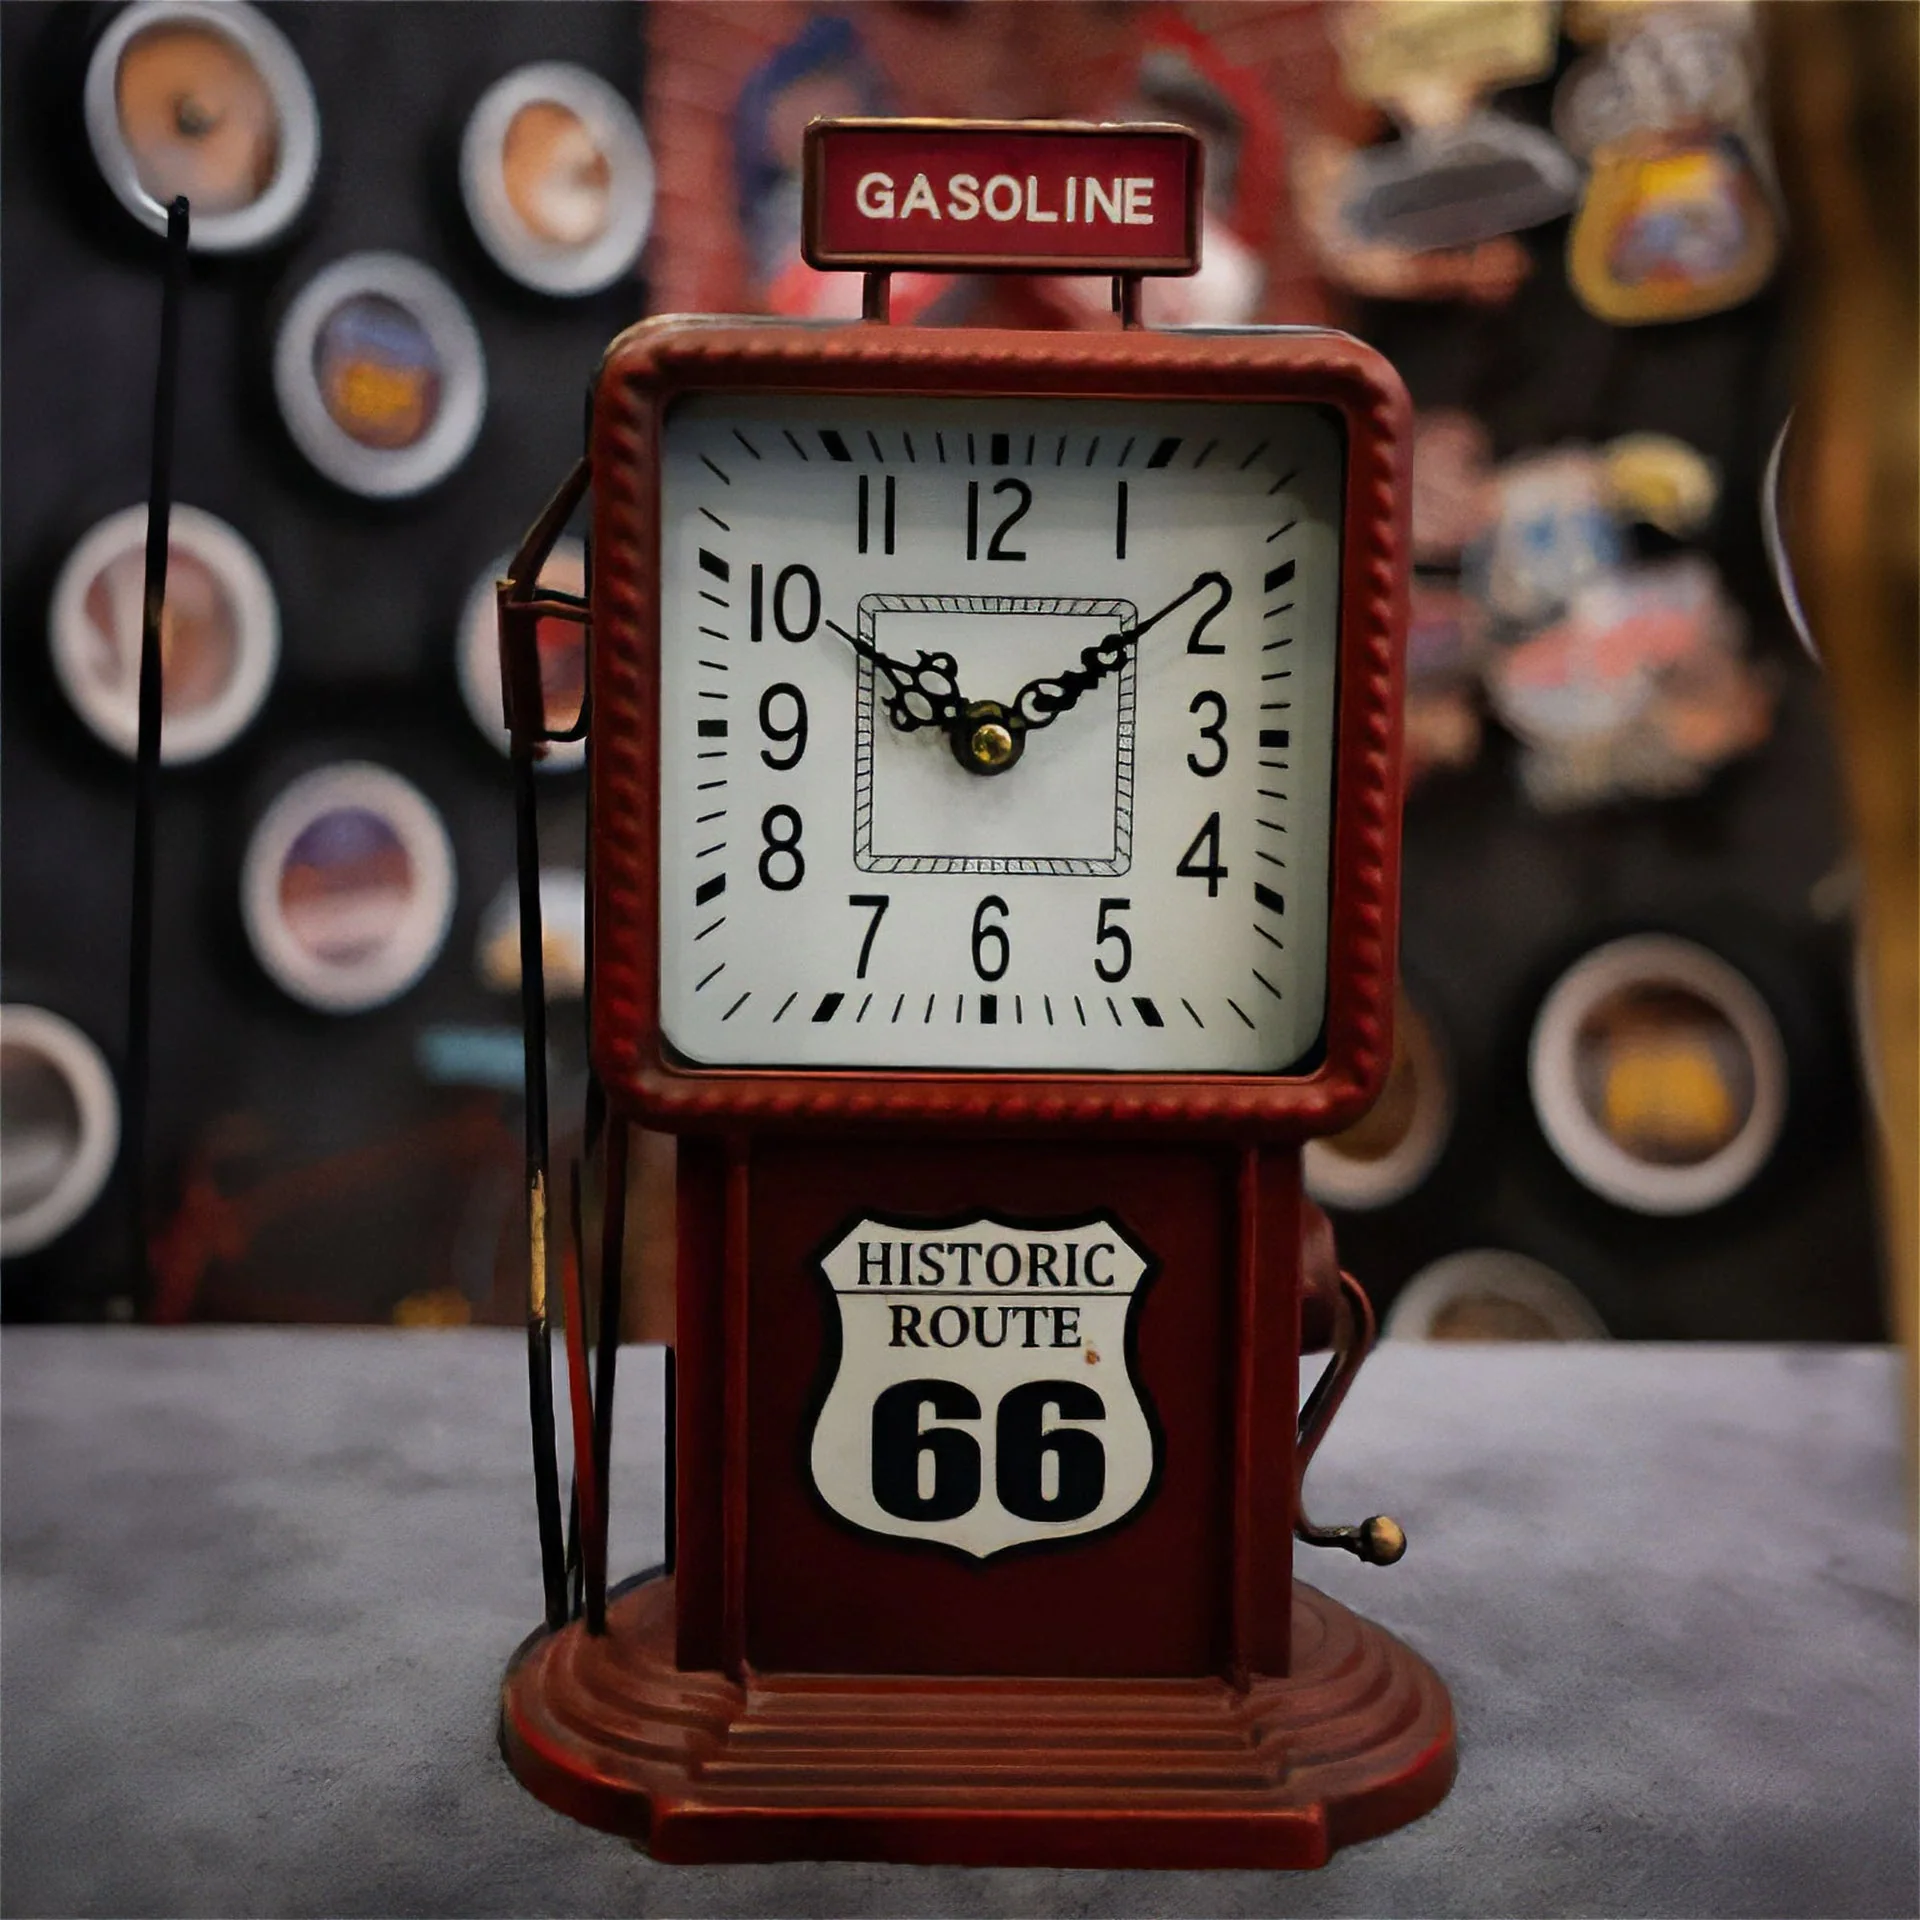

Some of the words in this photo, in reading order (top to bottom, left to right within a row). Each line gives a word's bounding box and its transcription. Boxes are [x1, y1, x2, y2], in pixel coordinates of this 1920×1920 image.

[856, 172, 1155, 225] GASOLINE
[858, 474, 896, 555] 11
[966, 478, 1033, 562] 12
[1115, 480, 1128, 560] 1
[749, 563, 821, 643] 10
[1187, 571, 1233, 655] 2
[758, 683, 809, 770] 9
[1187, 690, 1229, 777] 3
[757, 805, 805, 892] 8
[1176, 812, 1229, 897] 4
[848, 894, 890, 980] 7
[971, 895, 1010, 982] 6
[1093, 898, 1133, 983] 5
[857, 1242, 1115, 1287] HISTORIC
[888, 1305, 1082, 1348] ROUTE
[872, 1378, 1106, 1522] 66
